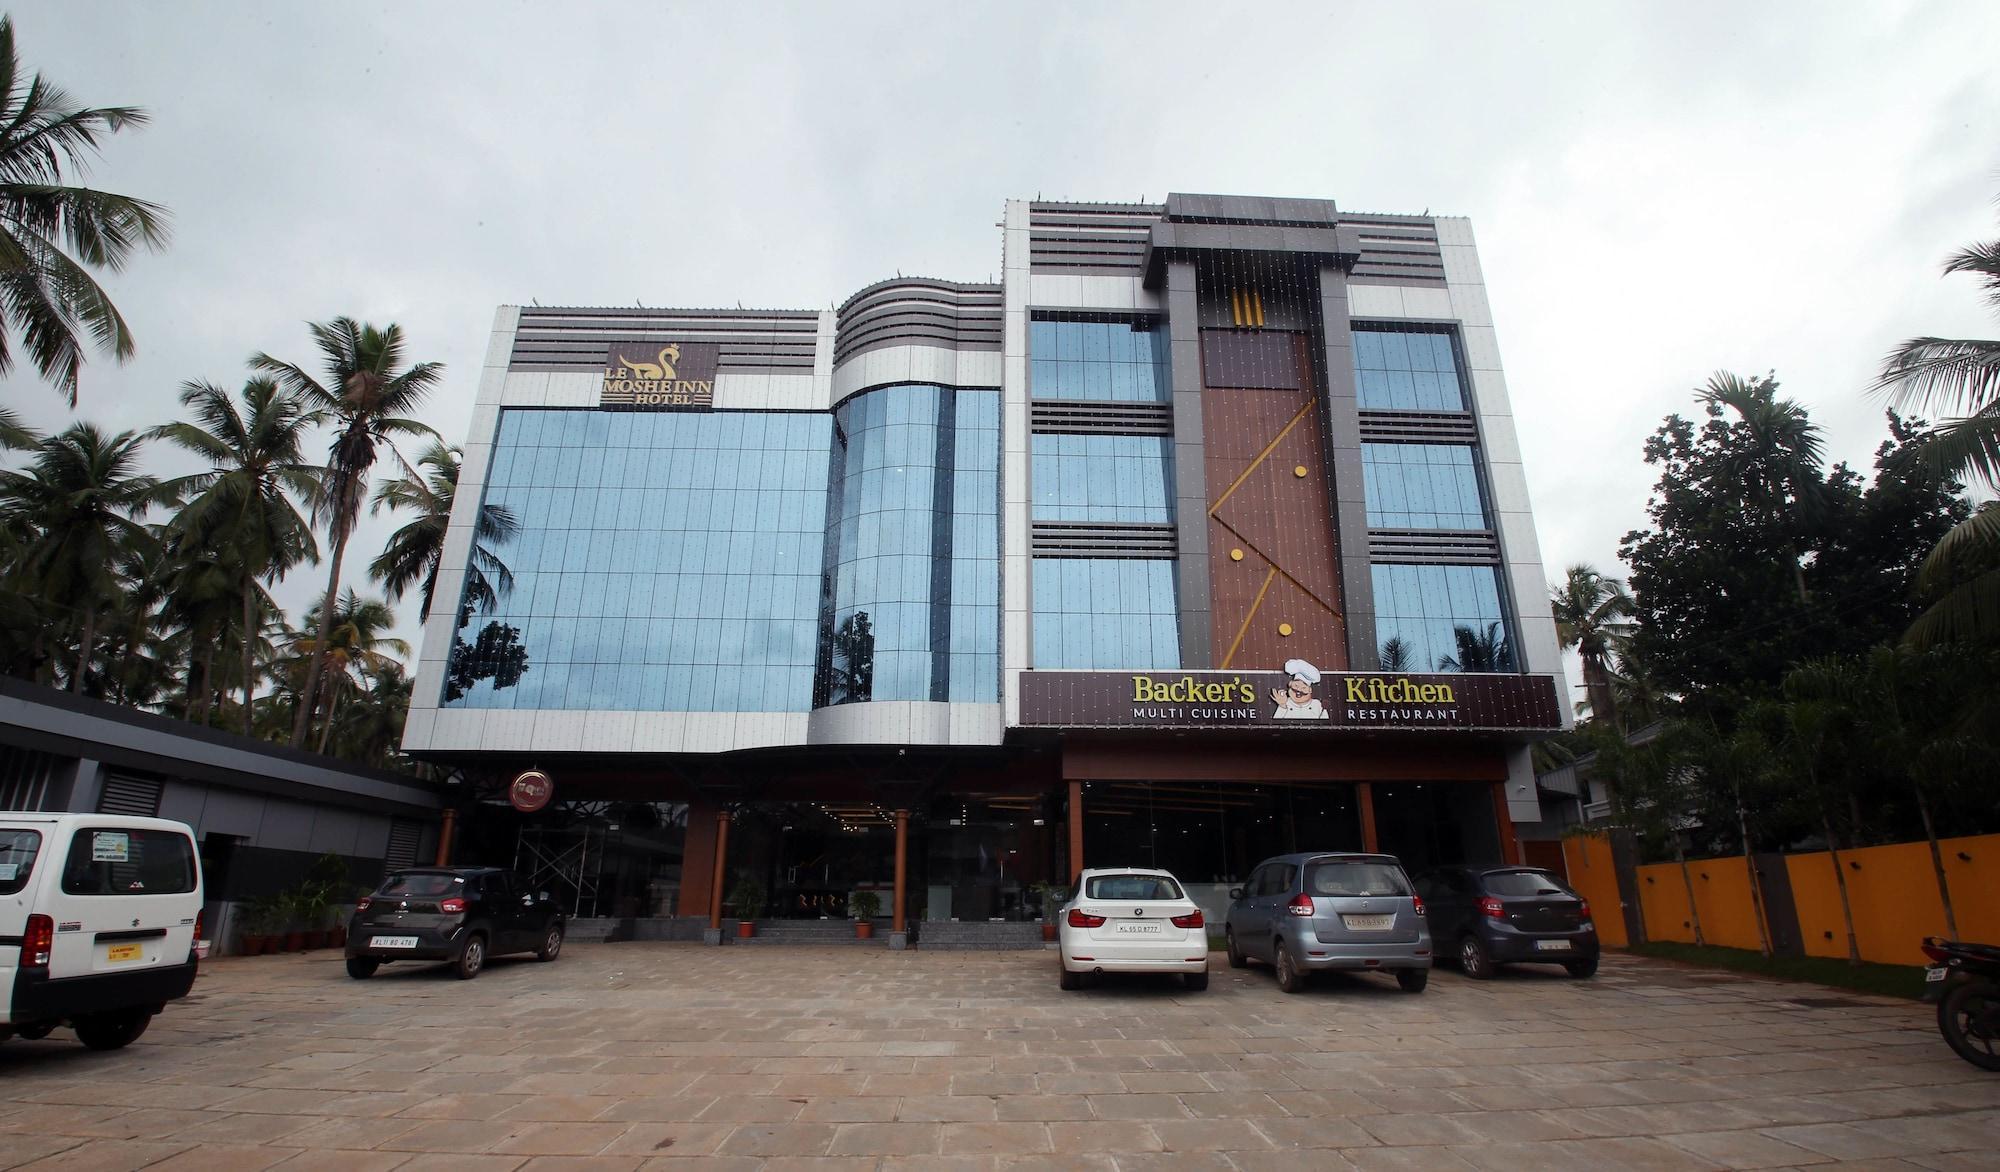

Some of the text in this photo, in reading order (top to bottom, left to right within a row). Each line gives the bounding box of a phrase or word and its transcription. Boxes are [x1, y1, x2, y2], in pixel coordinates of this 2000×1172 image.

[602, 380, 713, 394] MOSHE INN
[634, 393, 693, 405] HOTEL
[1132, 676, 1256, 703] Backer's
[1343, 677, 1456, 704] Kitchen
[1133, 707, 1258, 719] MULTI CUISINE
[1347, 708, 1458, 720] RESTAURANT
